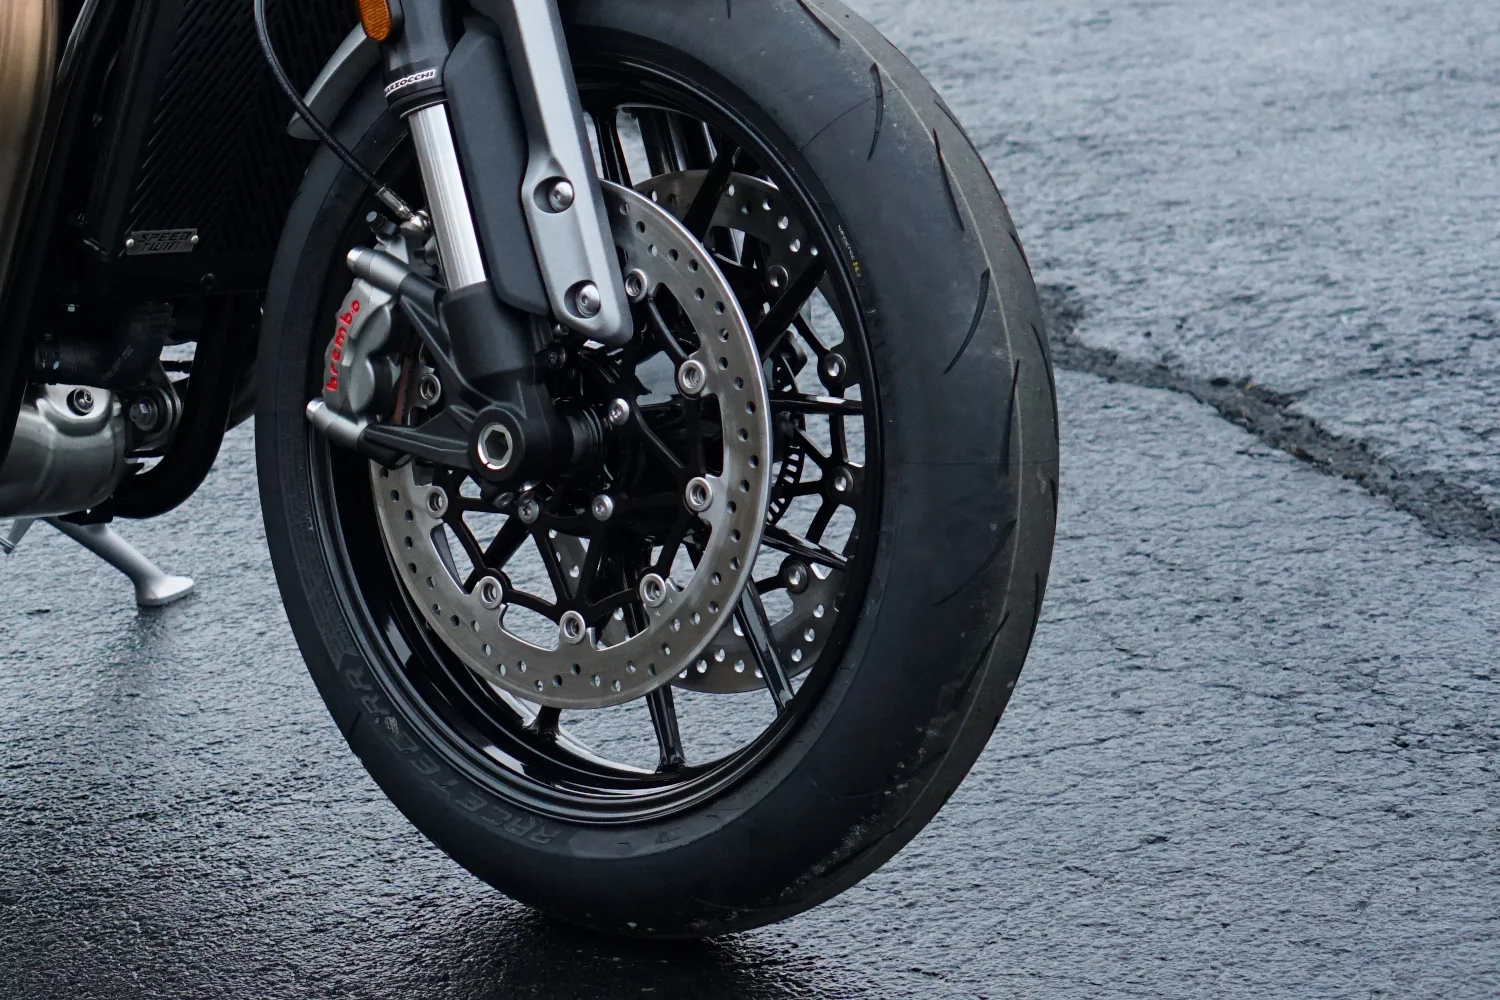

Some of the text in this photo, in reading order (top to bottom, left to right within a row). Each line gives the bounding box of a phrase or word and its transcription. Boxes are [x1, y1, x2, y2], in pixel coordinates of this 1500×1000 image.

[384, 70, 436, 96] ARZOCCHI
[136, 231, 193, 243] SPEED
[325, 299, 361, 393] brembo
